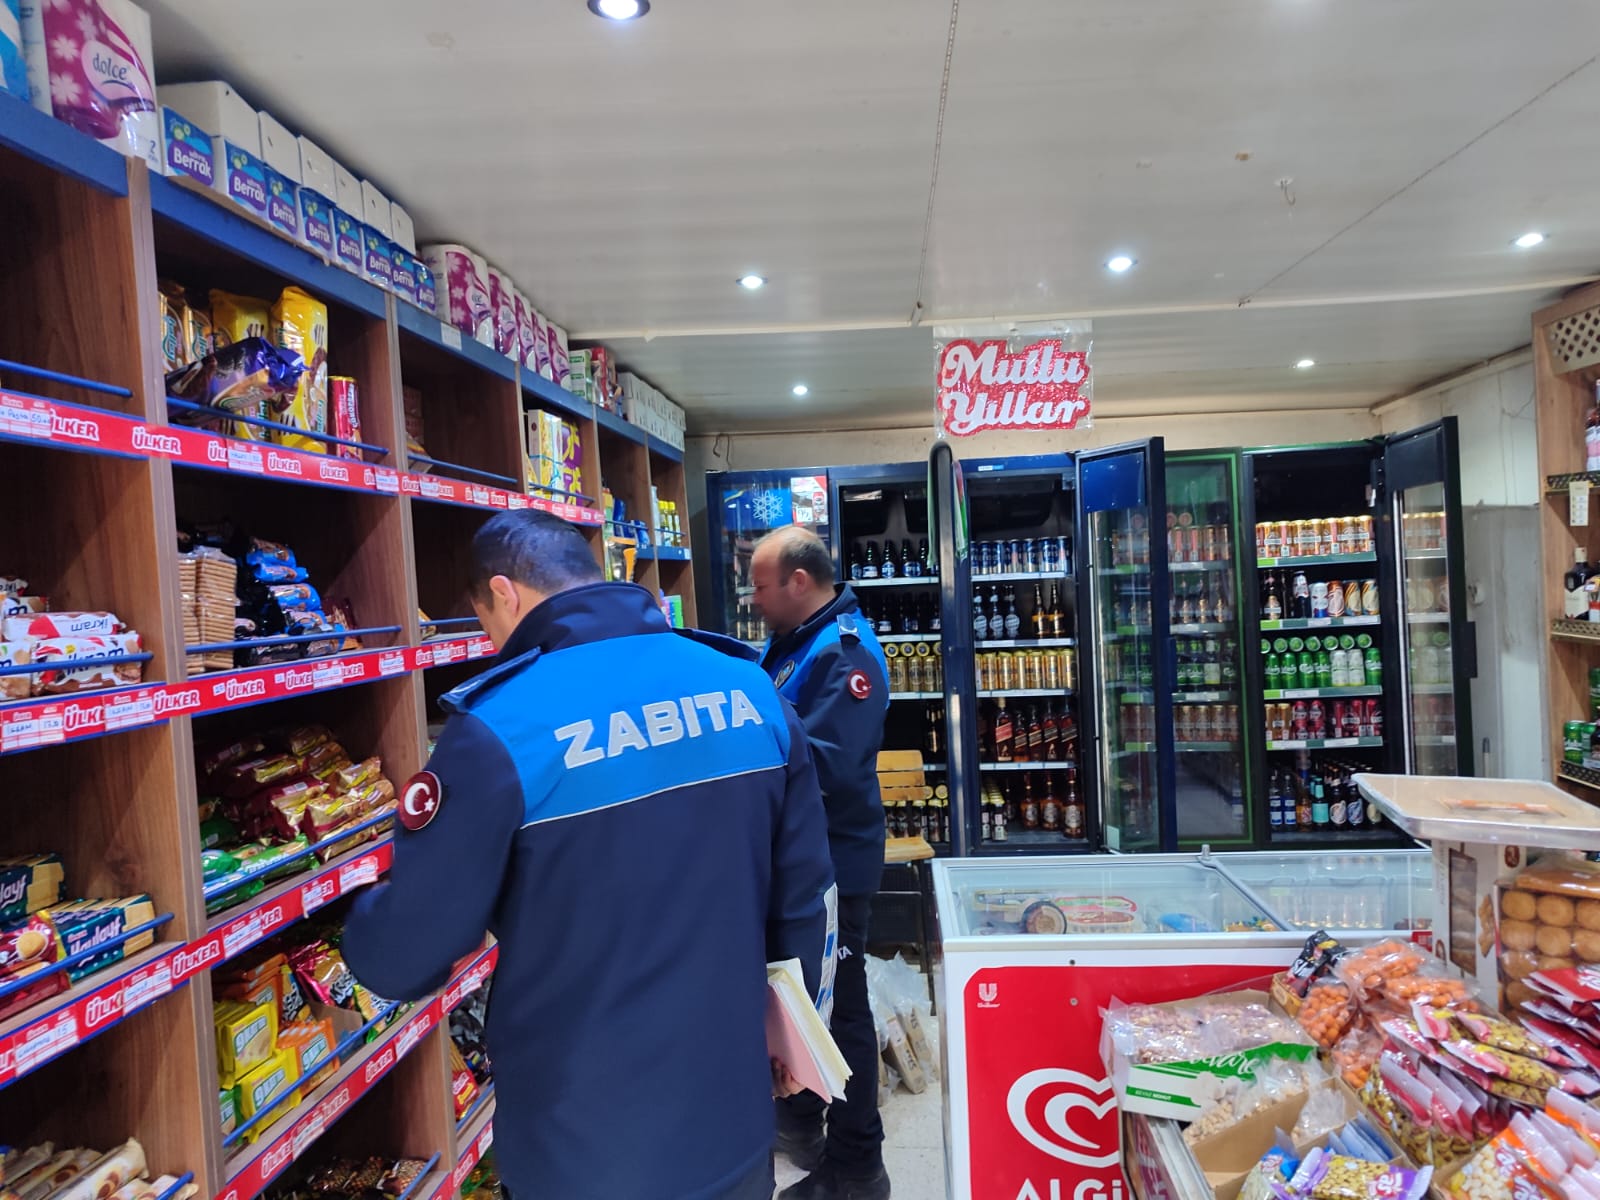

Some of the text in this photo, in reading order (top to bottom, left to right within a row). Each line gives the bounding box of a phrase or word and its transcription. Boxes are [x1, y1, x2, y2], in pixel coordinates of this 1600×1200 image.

[92, 53, 128, 81] dolce
[173, 147, 212, 179] Berrak
[233, 175, 265, 205] Berrak
[942, 345, 1085, 388] Mutlu
[50, 408, 99, 441] LKER
[132, 426, 182, 455] ÜLKER
[267, 452, 302, 475] ÜLKER
[319, 461, 348, 481] ÜLKER
[71, 619, 108, 632] ikram
[226, 678, 265, 701] ÜLKER
[285, 670, 313, 690] ÜLKE
[153, 689, 200, 714] ÜLKER
[554, 690, 763, 769] ZABITA
[258, 906, 283, 931] KER
[171, 940, 220, 979] ÜLKER
